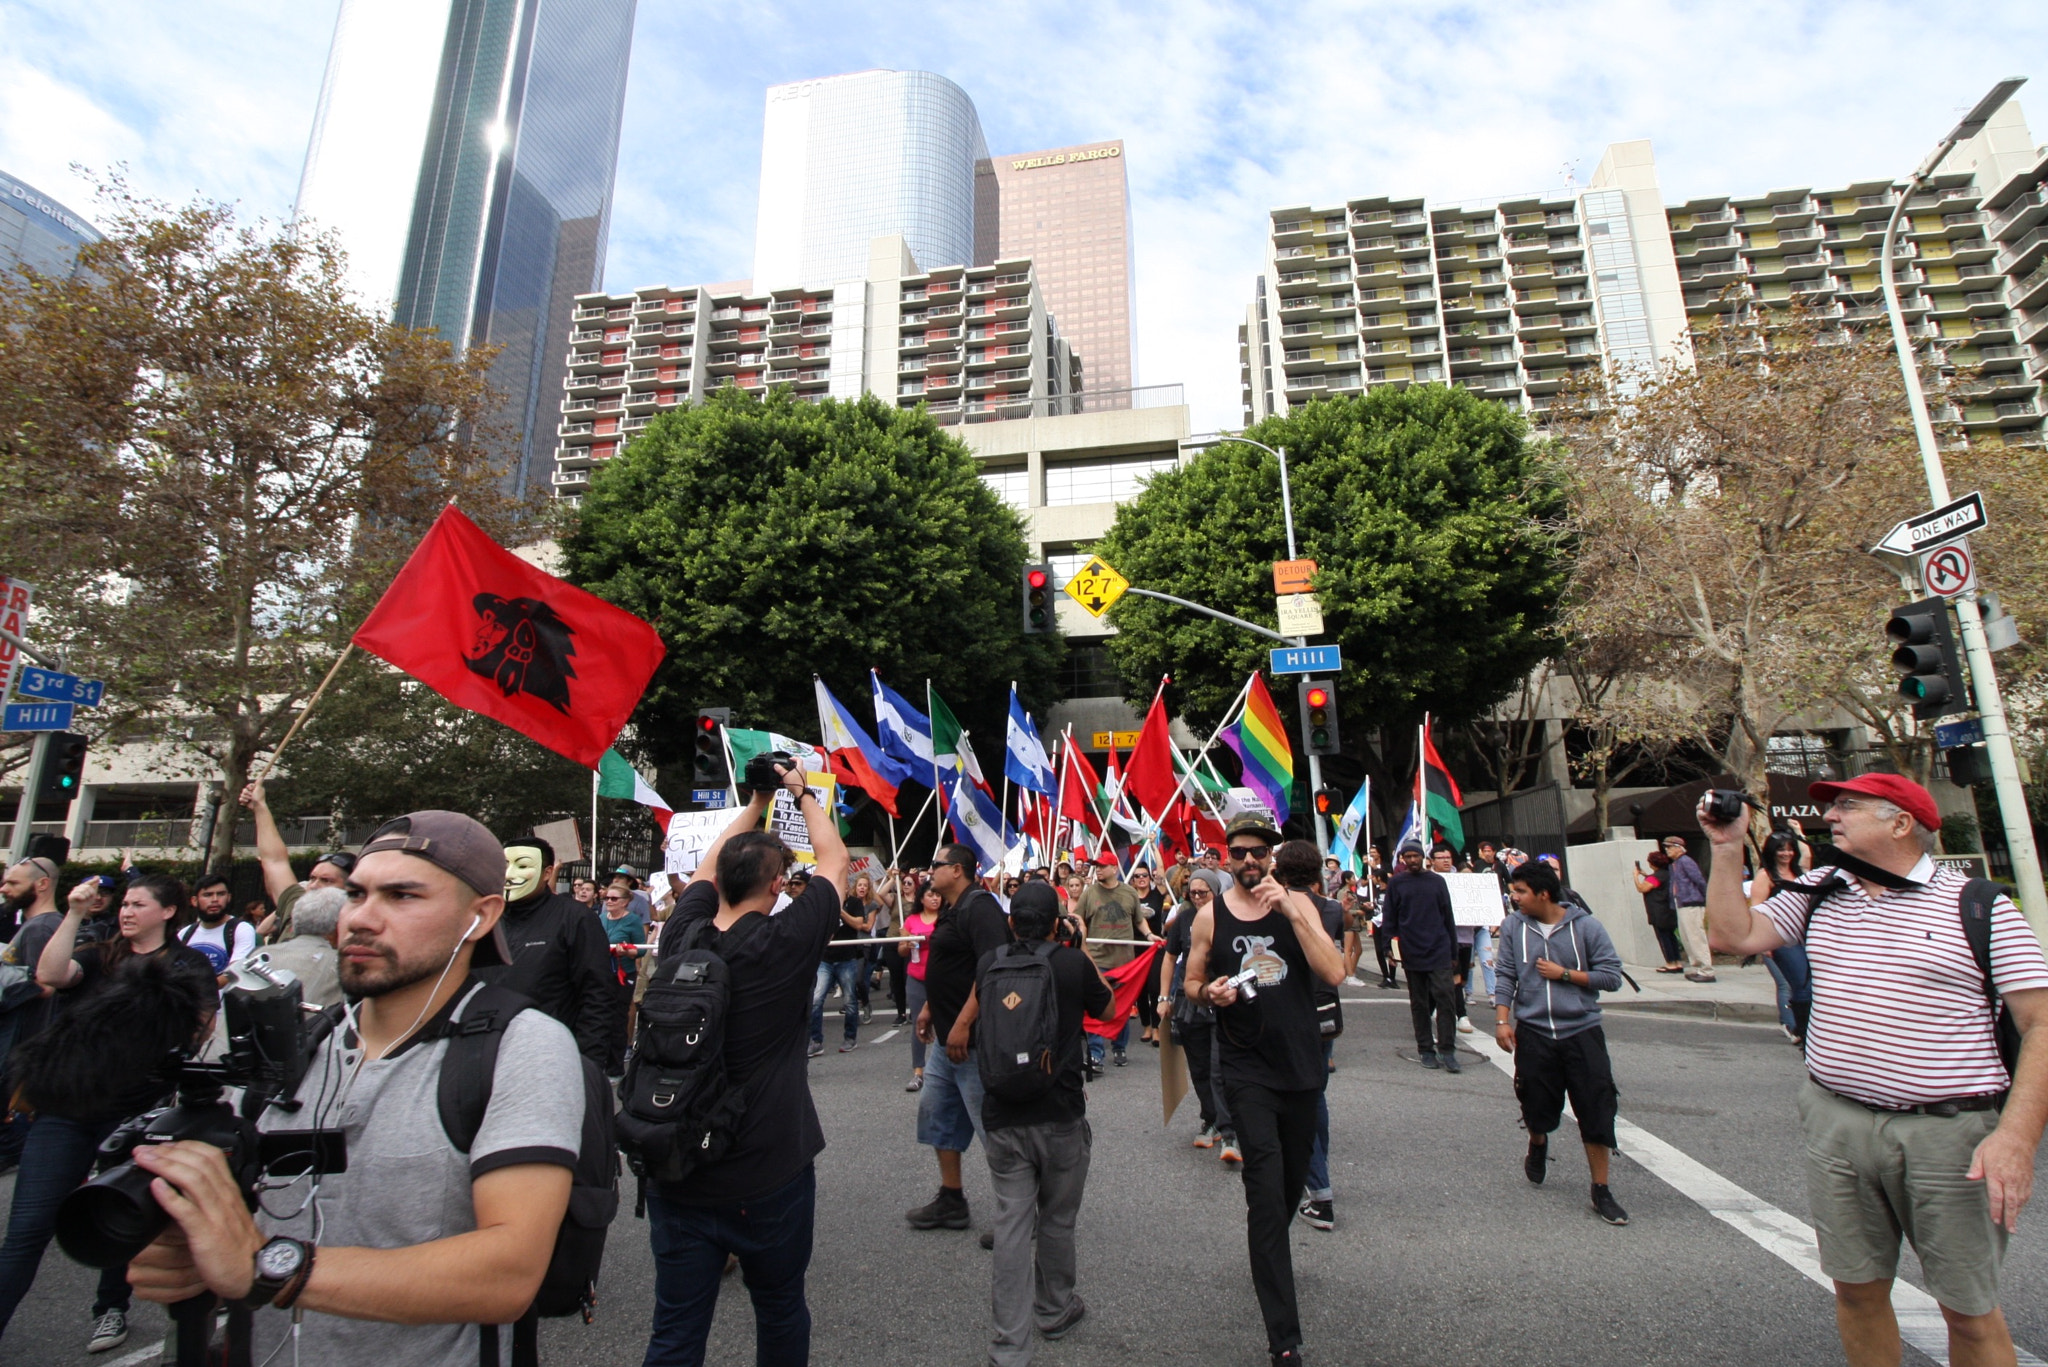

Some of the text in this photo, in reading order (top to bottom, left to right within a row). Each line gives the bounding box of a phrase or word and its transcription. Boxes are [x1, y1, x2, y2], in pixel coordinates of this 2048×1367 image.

[1012, 147, 1120, 170] WELLS FARGO
[11, 185, 79, 231] Deloitte
[1912, 507, 1971, 541] ONE WAY
[1279, 565, 1312, 575] DETOUR
[1287, 651, 1324, 665] Hill
[28, 673, 95, 700] 3rd St
[19, 709, 57, 722] Hill
[697, 791, 720, 799] Hill St
[778, 801, 788, 809] We
[1772, 805, 1821, 817] PLAZA
[780, 811, 788, 819] To
[779, 832, 809, 843] America
[1936, 860, 1973, 869] GELUS
